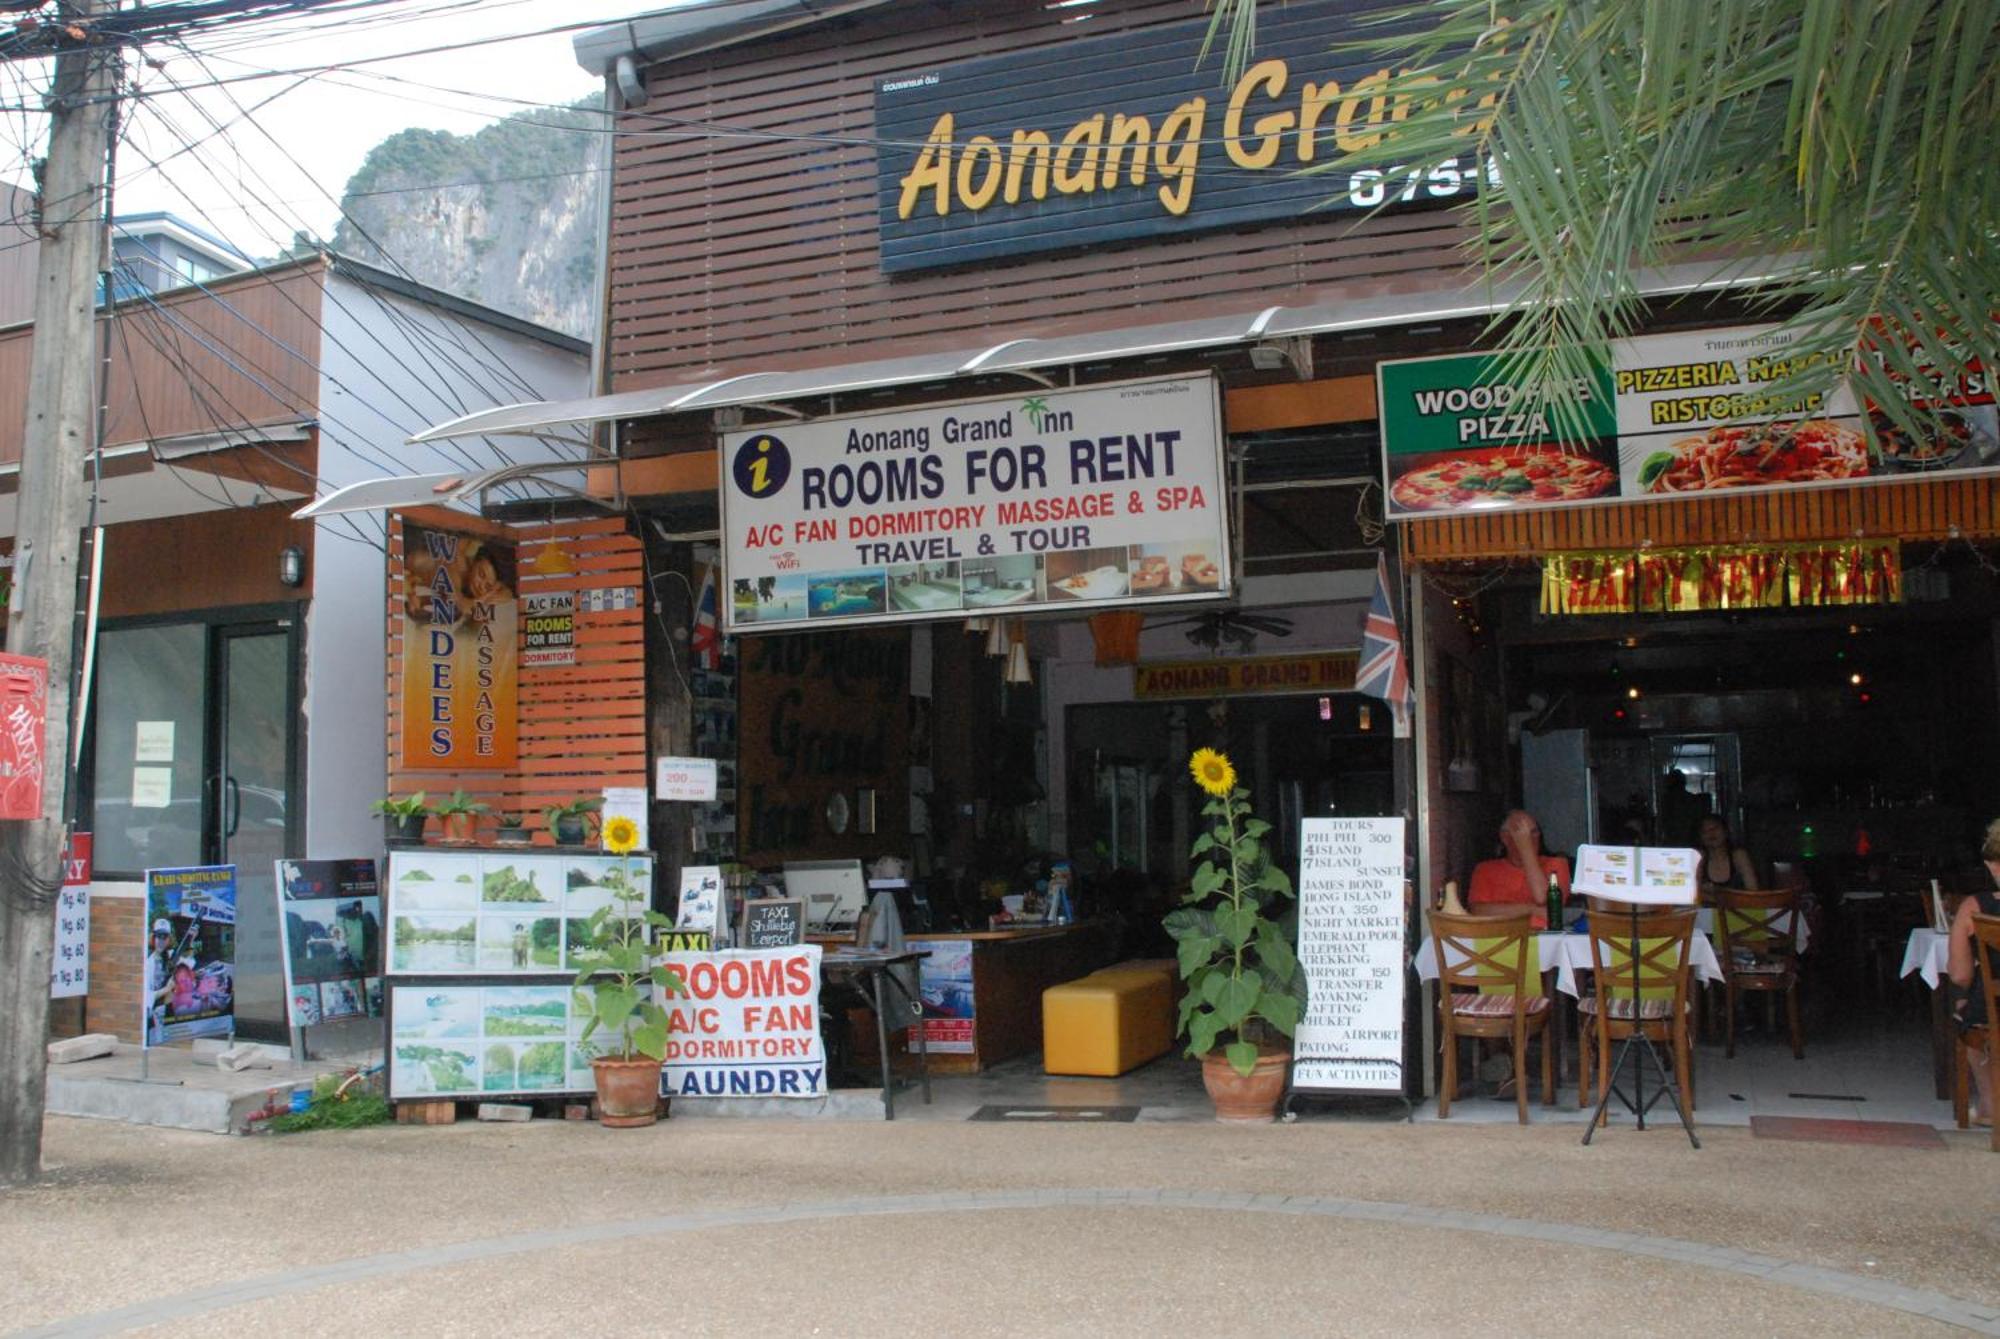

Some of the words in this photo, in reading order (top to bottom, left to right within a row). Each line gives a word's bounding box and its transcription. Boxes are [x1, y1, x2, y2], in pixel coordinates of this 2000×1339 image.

[899, 97, 1207, 218] Aonang
[1616, 359, 1739, 395] PIZZERIA
[1415, 382, 1516, 416] WOOD
[1525, 377, 1590, 404] FIE
[1651, 393, 1825, 425] RISTORATE
[845, 426, 930, 454] Aonang
[943, 411, 1012, 444] Grand
[1459, 411, 1550, 442] PIZZA
[802, 454, 945, 511] ROOMS
[967, 444, 1047, 495] FOR
[1070, 430, 1182, 485] RENT
[745, 524, 784, 548] A/C
[794, 518, 837, 543] FAN
[849, 505, 985, 539] DORMITORY
[998, 492, 1114, 525] MASSAGE
[1127, 490, 1145, 514] &
[1156, 485, 1206, 512] SPA
[856, 537, 962, 566] TRAVEL
[977, 533, 996, 556] &
[1010, 525, 1091, 552] TOUR
[527, 598, 546, 610] A/C
[550, 597, 572, 608] FAN
[527, 616, 572, 633] ROOMS
[424, 531, 458, 757] WANDEES
[527, 634, 545, 645] FOR
[548, 633, 572, 644] RENT
[525, 652, 575, 662] DORMITORY
[474, 601, 496, 756] MASSAGE
[1333, 821, 1374, 830] TOURS
[1307, 833, 1329, 842] PHI
[1334, 833, 1356, 842] PHI
[1368, 833, 1392, 843] 300
[1357, 866, 1402, 876] SUNSET
[1304, 880, 1345, 890] JAMES
[1348, 880, 1383, 890] BOND
[1343, 891, 1392, 901] ISLAND
[760, 906, 789, 919] TAXI
[1353, 904, 1379, 915] 350
[1346, 917, 1401, 927] MARKET
[659, 934, 709, 951] TAXI
[663, 956, 811, 1000] ROOMS
[1317, 979, 1383, 990] TRANSFER
[667, 1007, 720, 1034] A/C
[743, 1004, 813, 1033] FAN
[1344, 1029, 1400, 1040] AIRPORT
[666, 1037, 812, 1059] DORMITORY
[660, 1067, 822, 1096] LAUNDRY
